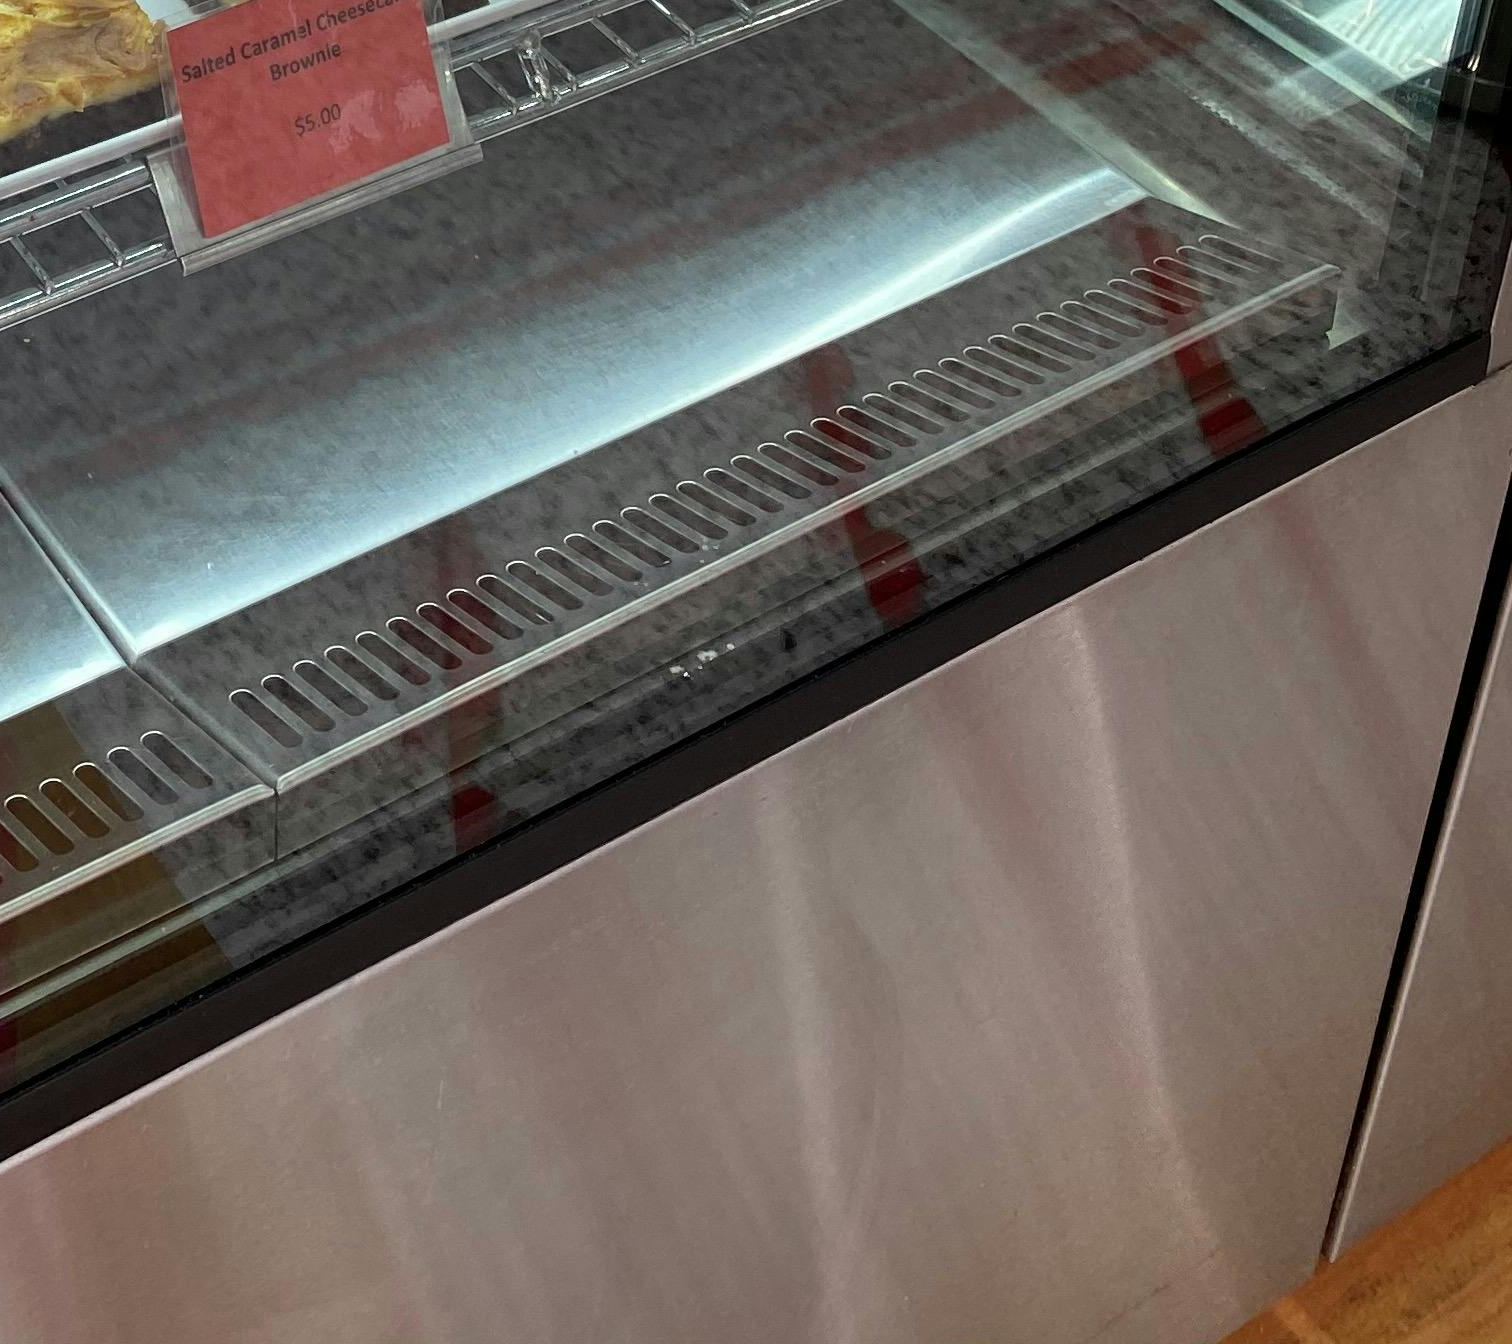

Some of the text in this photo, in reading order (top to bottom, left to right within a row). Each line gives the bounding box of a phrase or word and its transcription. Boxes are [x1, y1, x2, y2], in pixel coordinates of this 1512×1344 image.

[181, 46, 236, 84] Salted
[241, 19, 313, 60] Caramel
[269, 42, 342, 82] Brownie
[294, 103, 341, 138] $5.00
